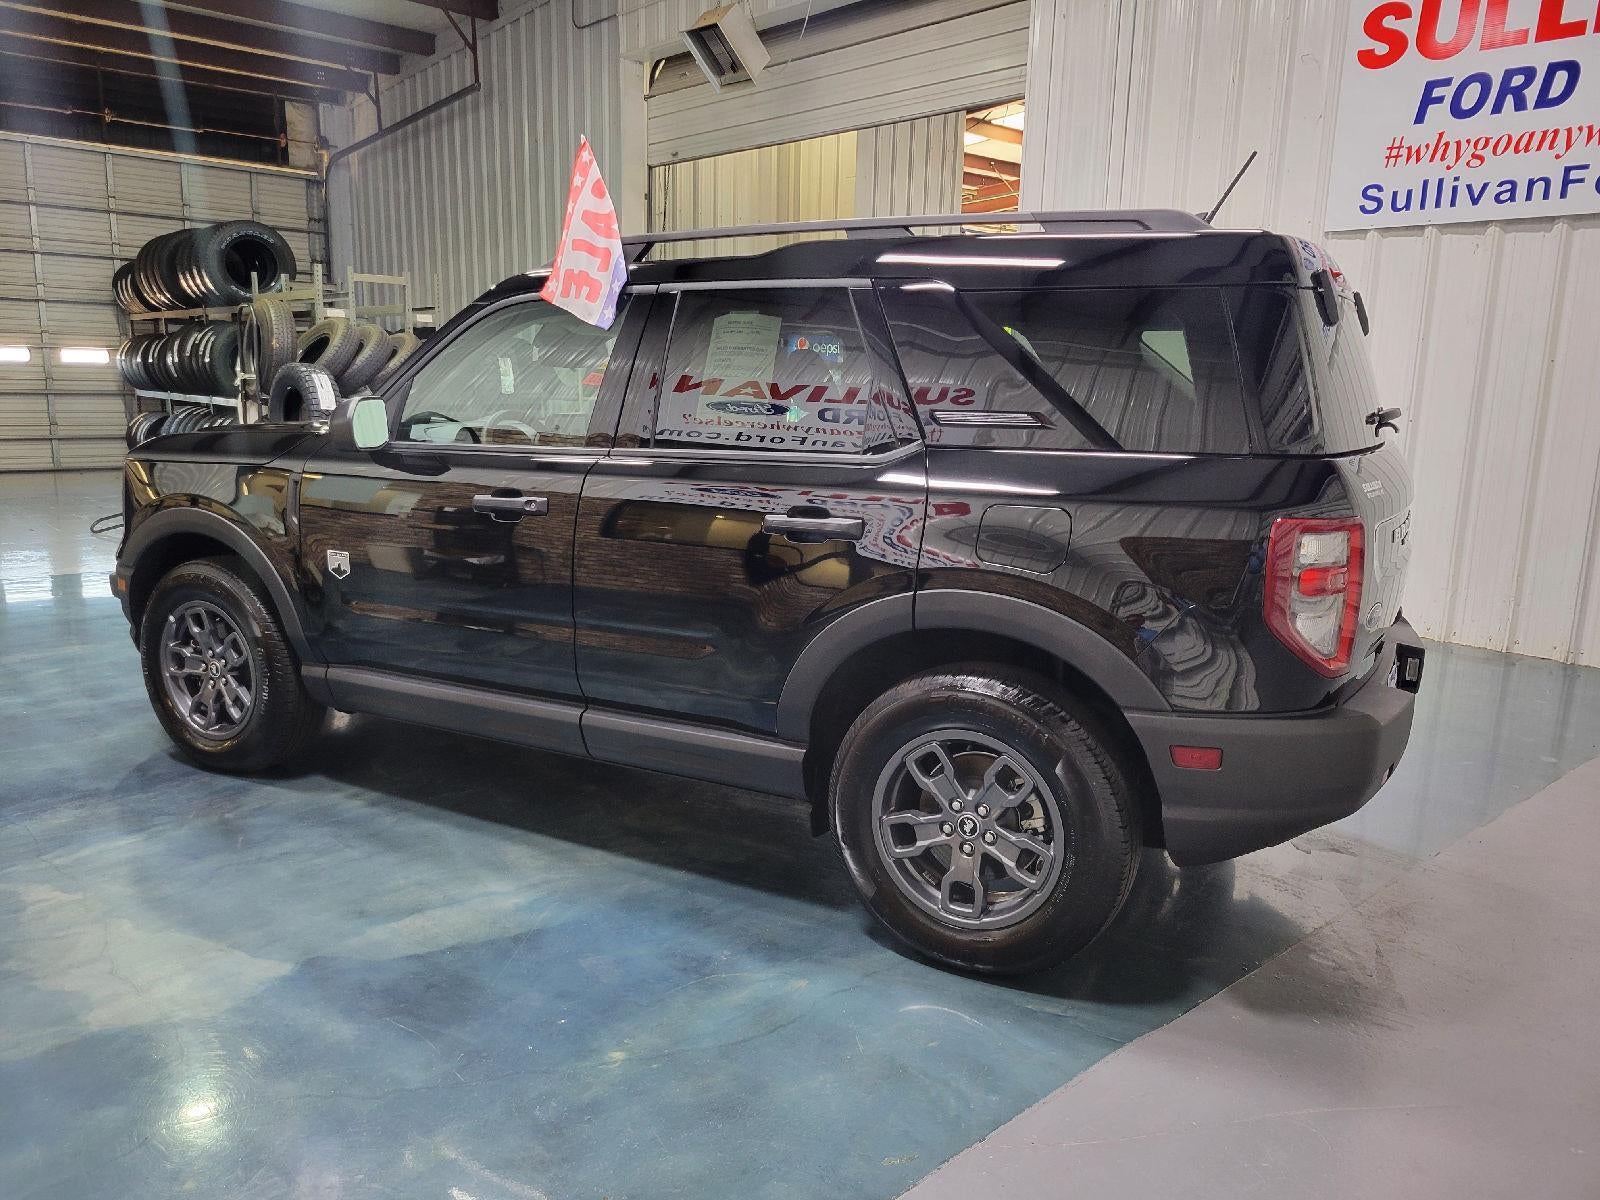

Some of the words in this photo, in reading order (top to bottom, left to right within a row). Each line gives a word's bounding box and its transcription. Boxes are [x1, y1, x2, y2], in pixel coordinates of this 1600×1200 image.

[1357, 0, 1600, 69] SULL
[1413, 59, 1581, 125] FORD
[1359, 164, 1600, 215] SullivanF
